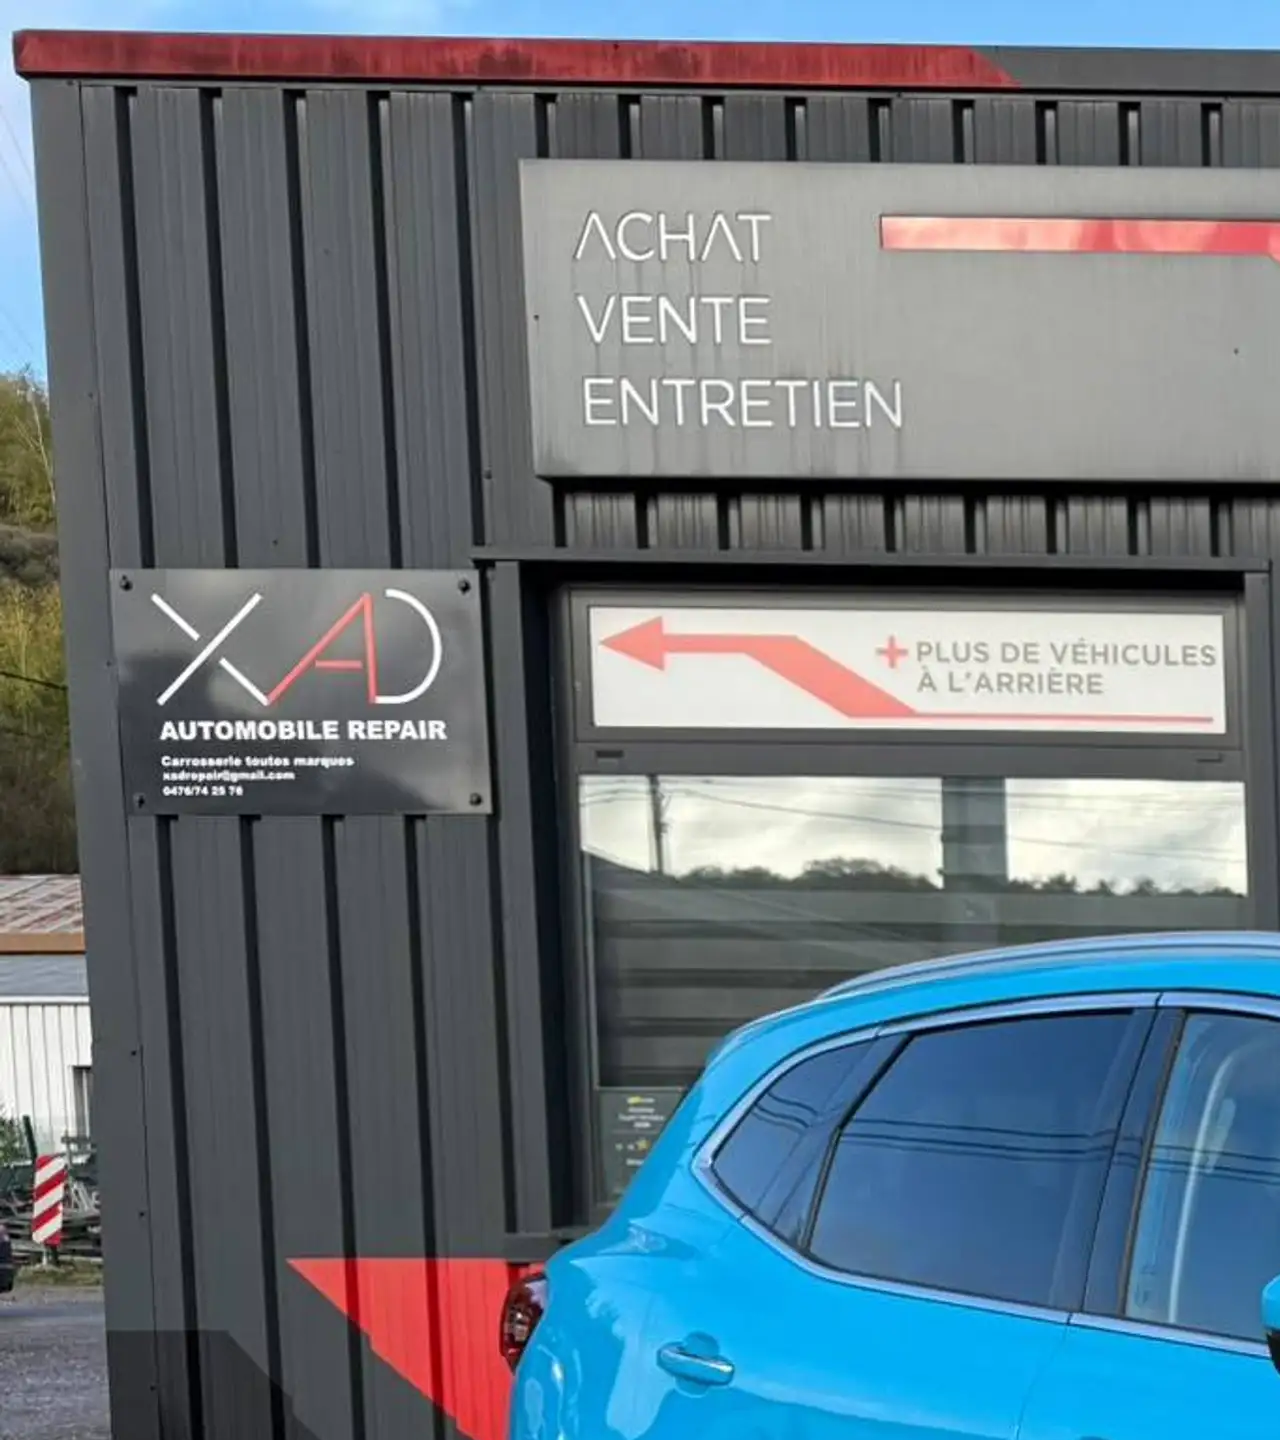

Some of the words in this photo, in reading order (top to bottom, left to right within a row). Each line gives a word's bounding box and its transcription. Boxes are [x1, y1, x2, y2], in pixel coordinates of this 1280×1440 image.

[575, 212, 772, 262] ACHAT
[577, 295, 772, 344] VENTE
[584, 378, 902, 428] ENTRETIEN
[151, 588, 442, 706] XAD
[916, 641, 989, 664] PLUS
[1001, 641, 1039, 664] DE
[1049, 637, 1216, 667] VÉHICULES
[917, 665, 939, 694] À
[948, 667, 1105, 696] L'ARRIÈRE
[160, 720, 339, 741] AUTOMOBILE
[347, 720, 447, 740] REPAIR
[161, 755, 242, 767] Carrosserie
[245, 755, 290, 767] toutes
[294, 756, 355, 769] marques
